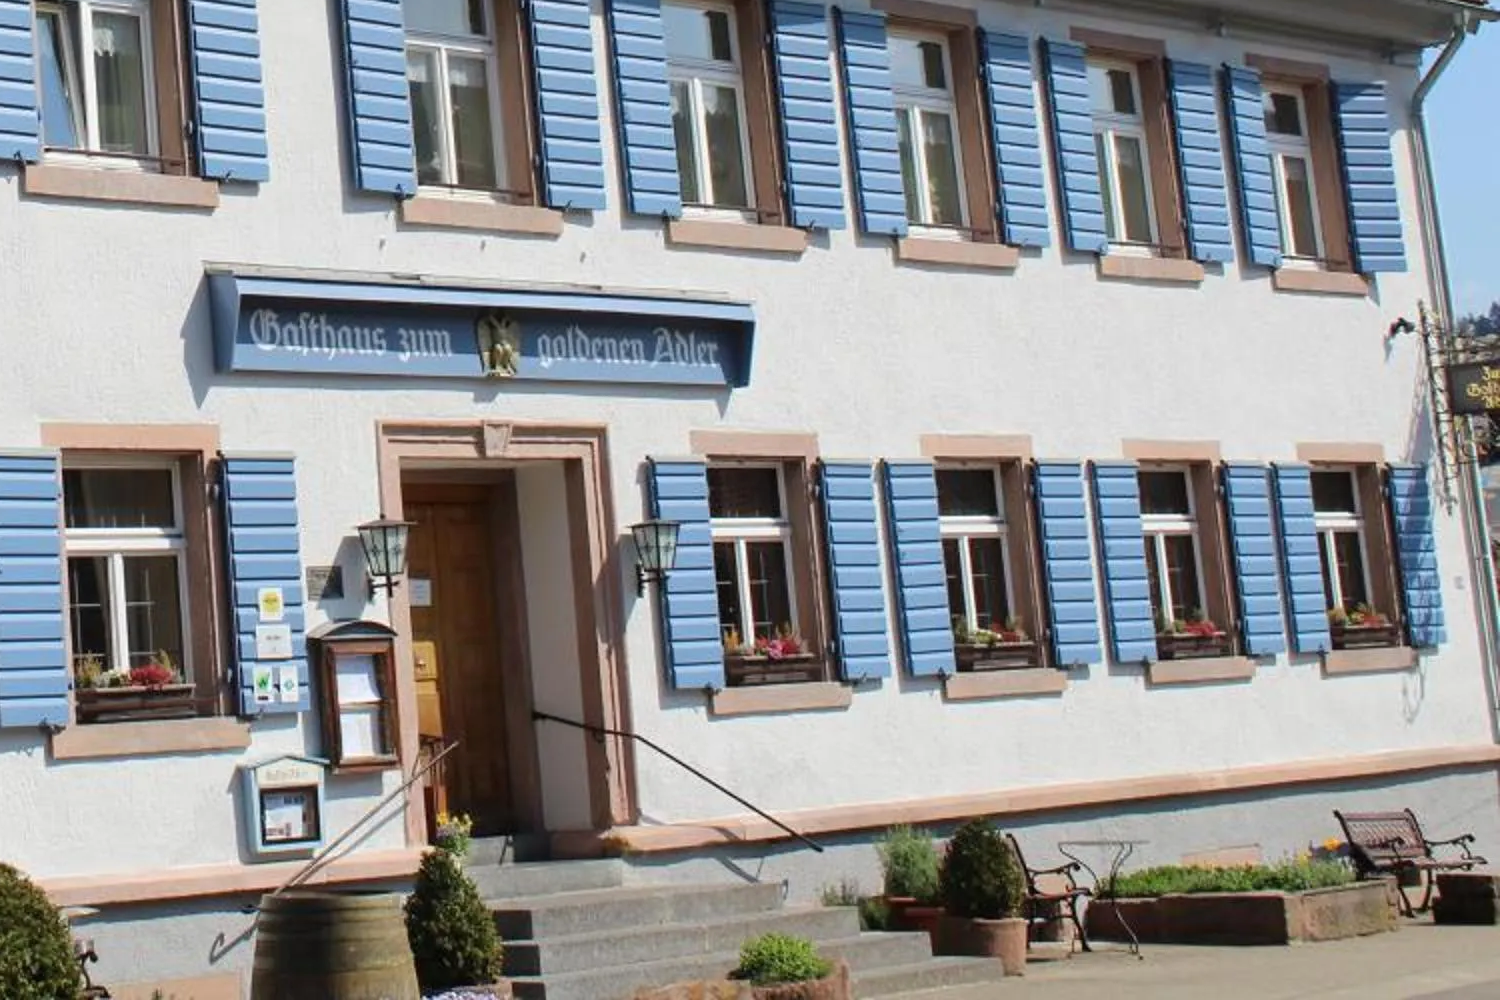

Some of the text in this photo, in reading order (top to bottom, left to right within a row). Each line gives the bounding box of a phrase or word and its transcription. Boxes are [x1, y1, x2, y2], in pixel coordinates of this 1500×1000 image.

[250, 308, 719, 369] Gasthaus zum goldenen Adler
